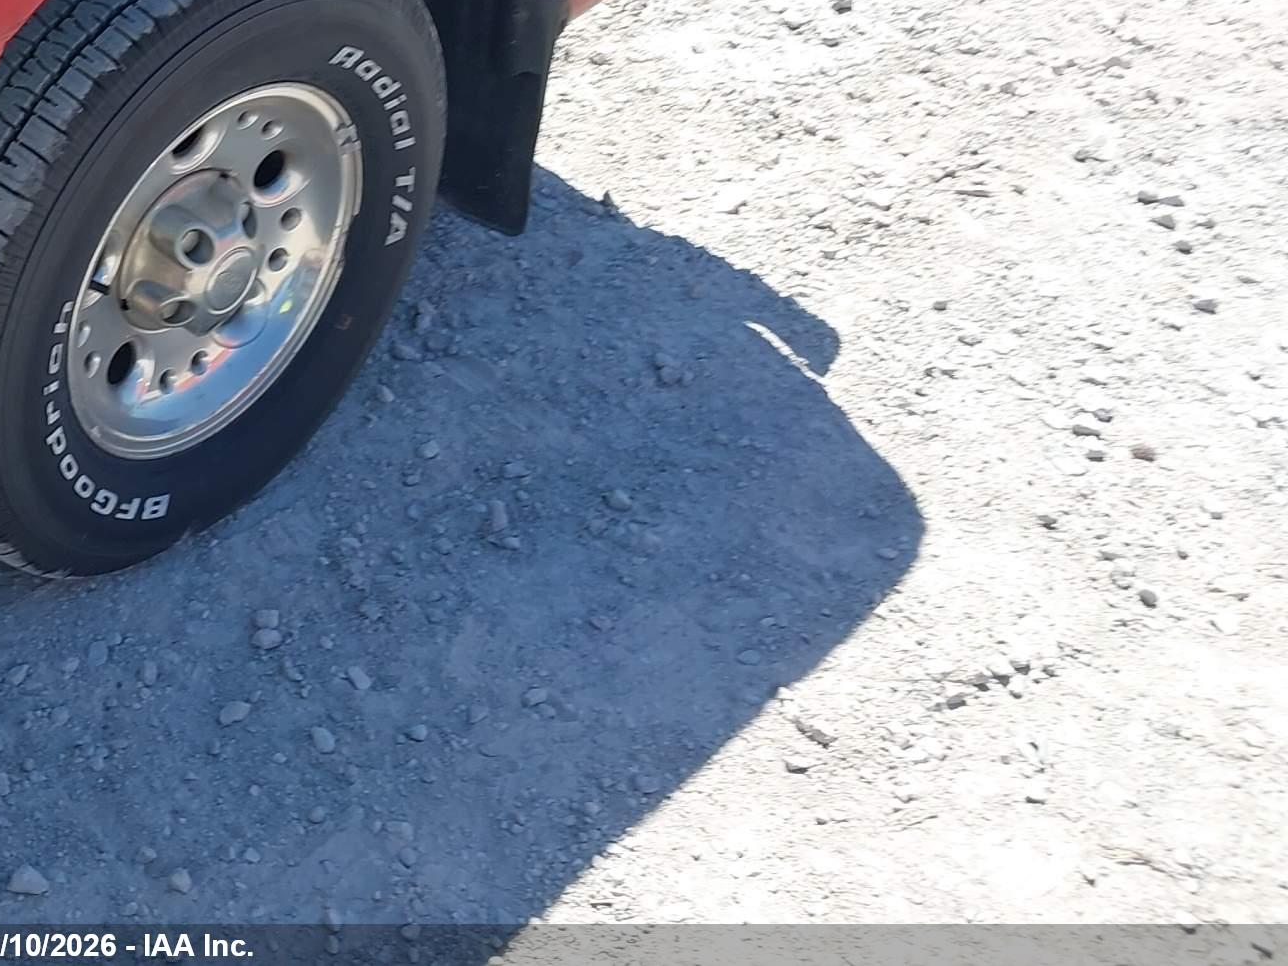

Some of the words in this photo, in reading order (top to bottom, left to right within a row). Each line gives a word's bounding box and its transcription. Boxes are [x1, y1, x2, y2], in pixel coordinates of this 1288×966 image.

[328, 45, 416, 151] Radial
[384, 166, 416, 247] T/A
[43, 300, 171, 520] BFGoodrich
